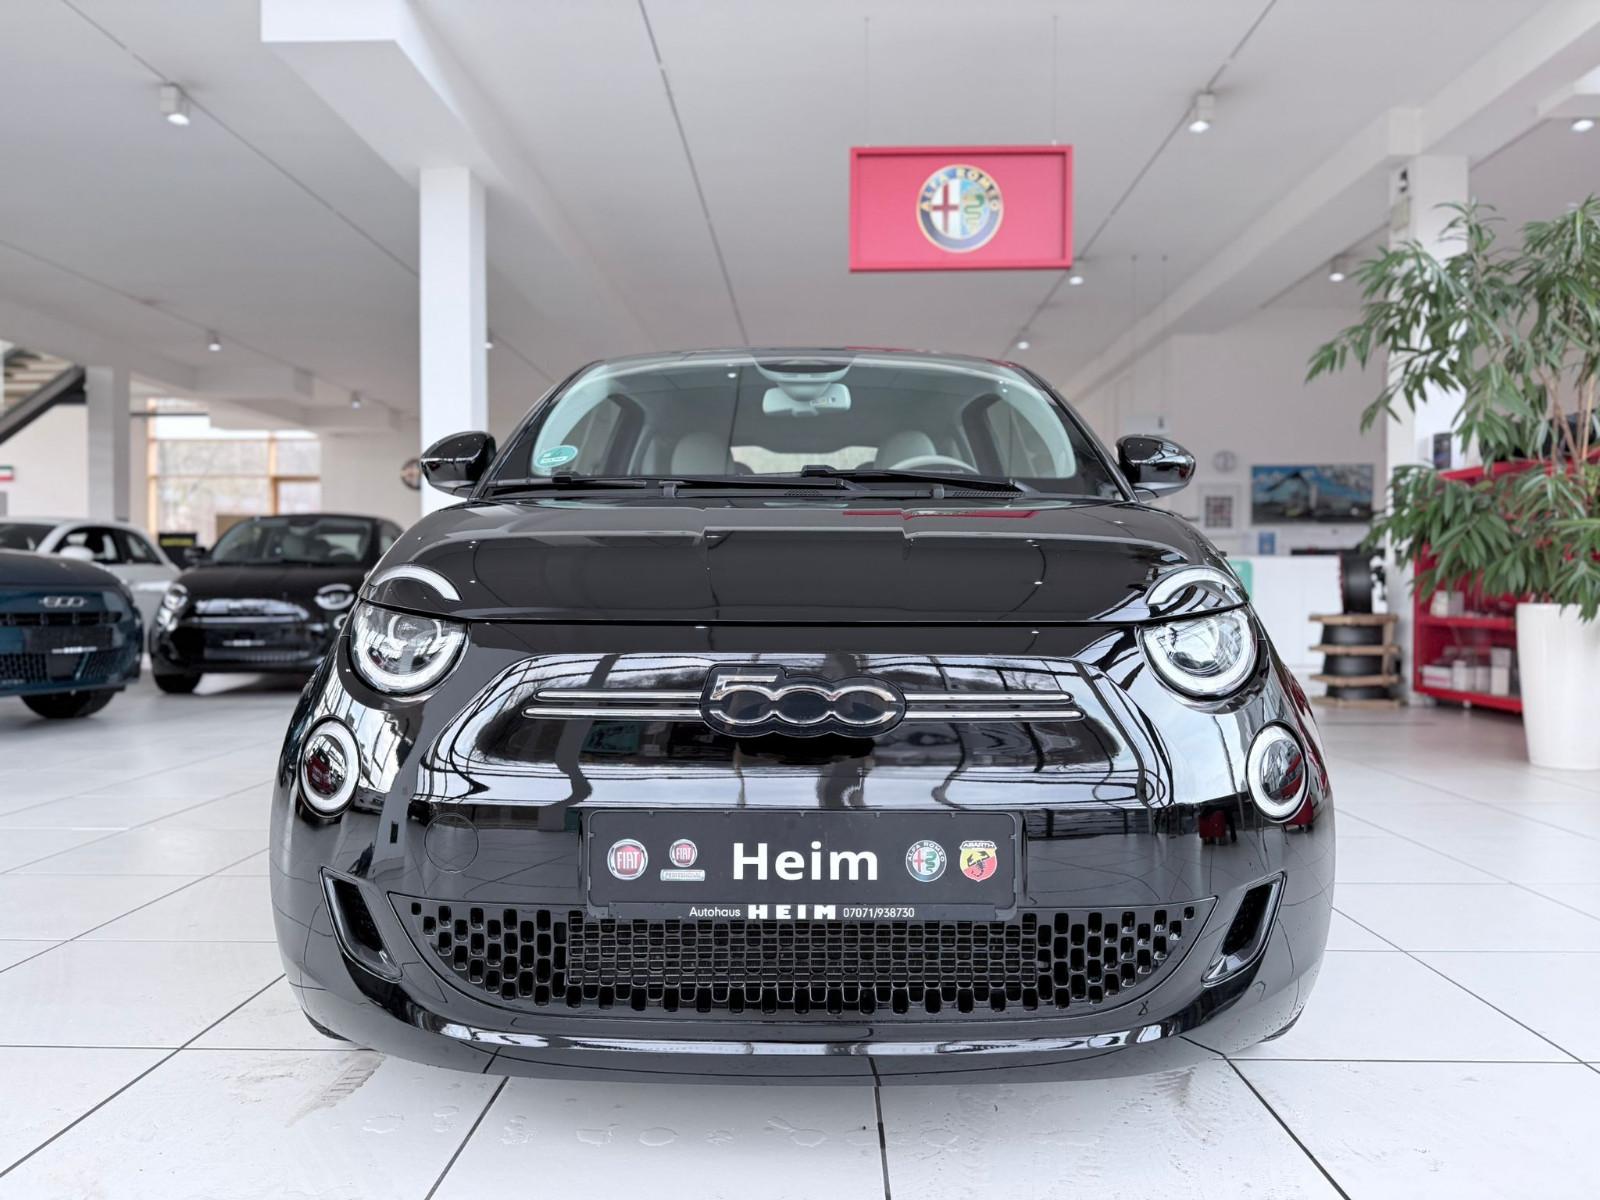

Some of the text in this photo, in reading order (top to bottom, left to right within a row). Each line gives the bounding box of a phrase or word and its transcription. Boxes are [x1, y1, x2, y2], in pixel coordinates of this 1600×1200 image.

[708, 674, 897, 725] 500
[617, 851, 640, 870] FIAT
[676, 847, 692, 860] FIAT
[733, 841, 878, 881] Heim
[908, 841, 945, 862] ALFA ROMEO
[689, 904, 915, 920] Autohaus HEIM 07071/938730
